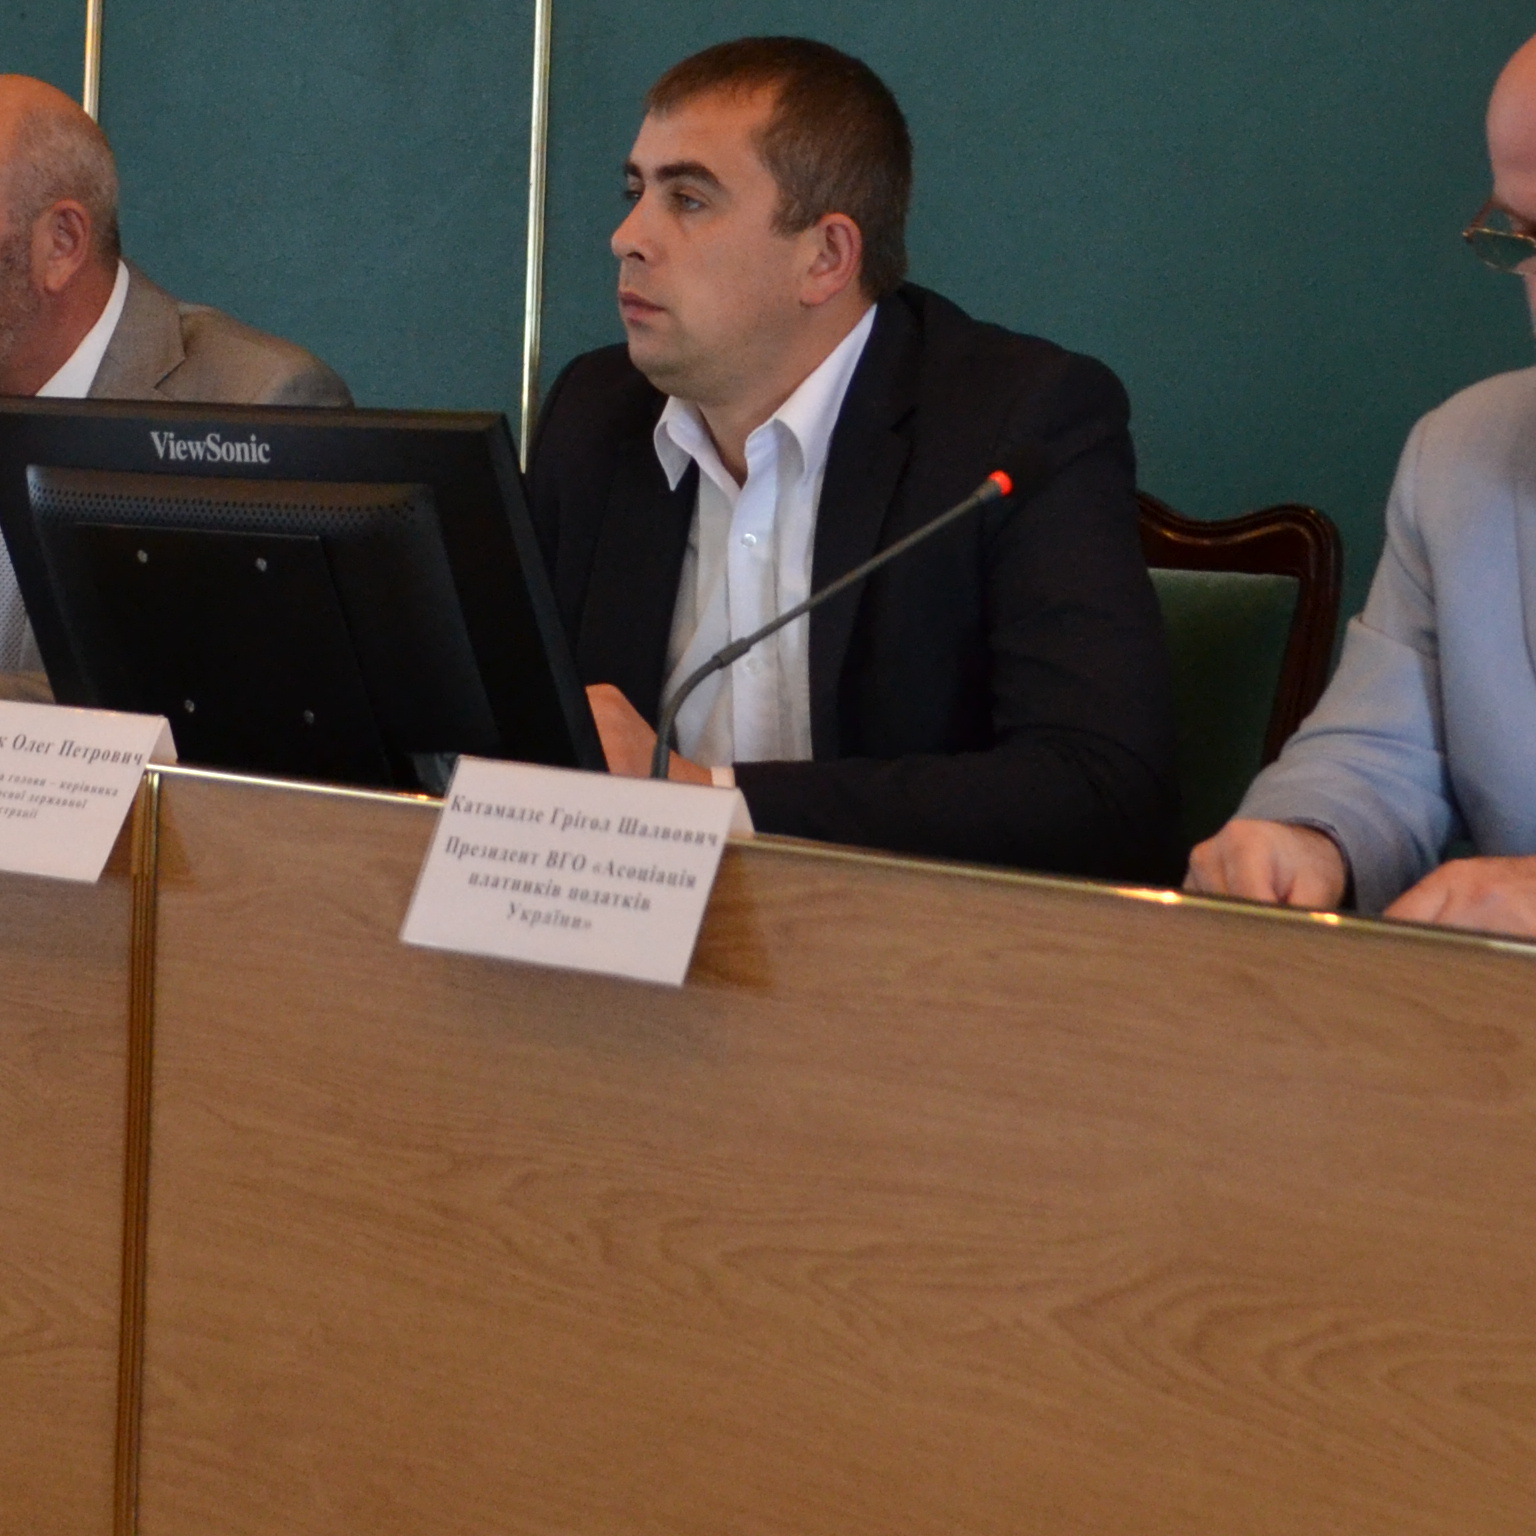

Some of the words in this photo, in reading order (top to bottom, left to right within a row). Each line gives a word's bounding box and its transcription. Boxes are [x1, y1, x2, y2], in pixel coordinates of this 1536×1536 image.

[150, 430, 271, 463] ViewSonic
[12, 733, 55, 755] Олег
[58, 739, 144, 767] Петрович
[450, 794, 545, 825] Катамадзе
[550, 807, 611, 833] Грігол
[617, 815, 718, 848] Шалвович
[445, 835, 540, 866] Президент
[545, 849, 587, 872] ВГО
[467, 869, 562, 899] платників
[567, 886, 652, 913] податків
